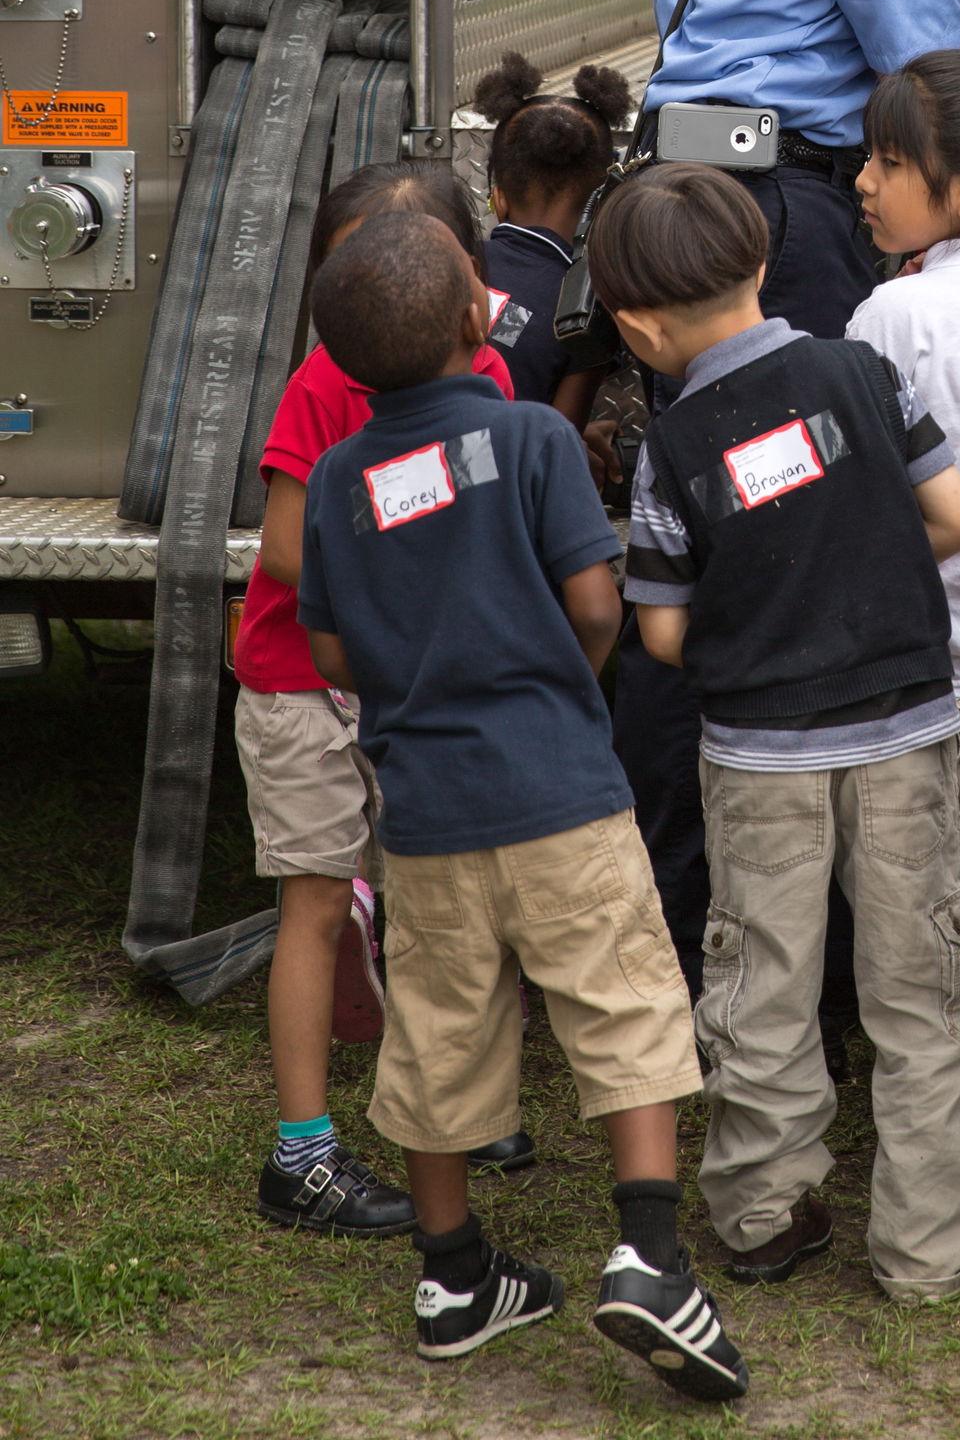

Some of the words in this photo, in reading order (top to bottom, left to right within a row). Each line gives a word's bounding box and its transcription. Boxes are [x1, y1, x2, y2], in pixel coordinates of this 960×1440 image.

[35, 102, 106, 113] WARNING
[744, 463, 807, 496] Brayan
[383, 486, 438, 517] Corey
